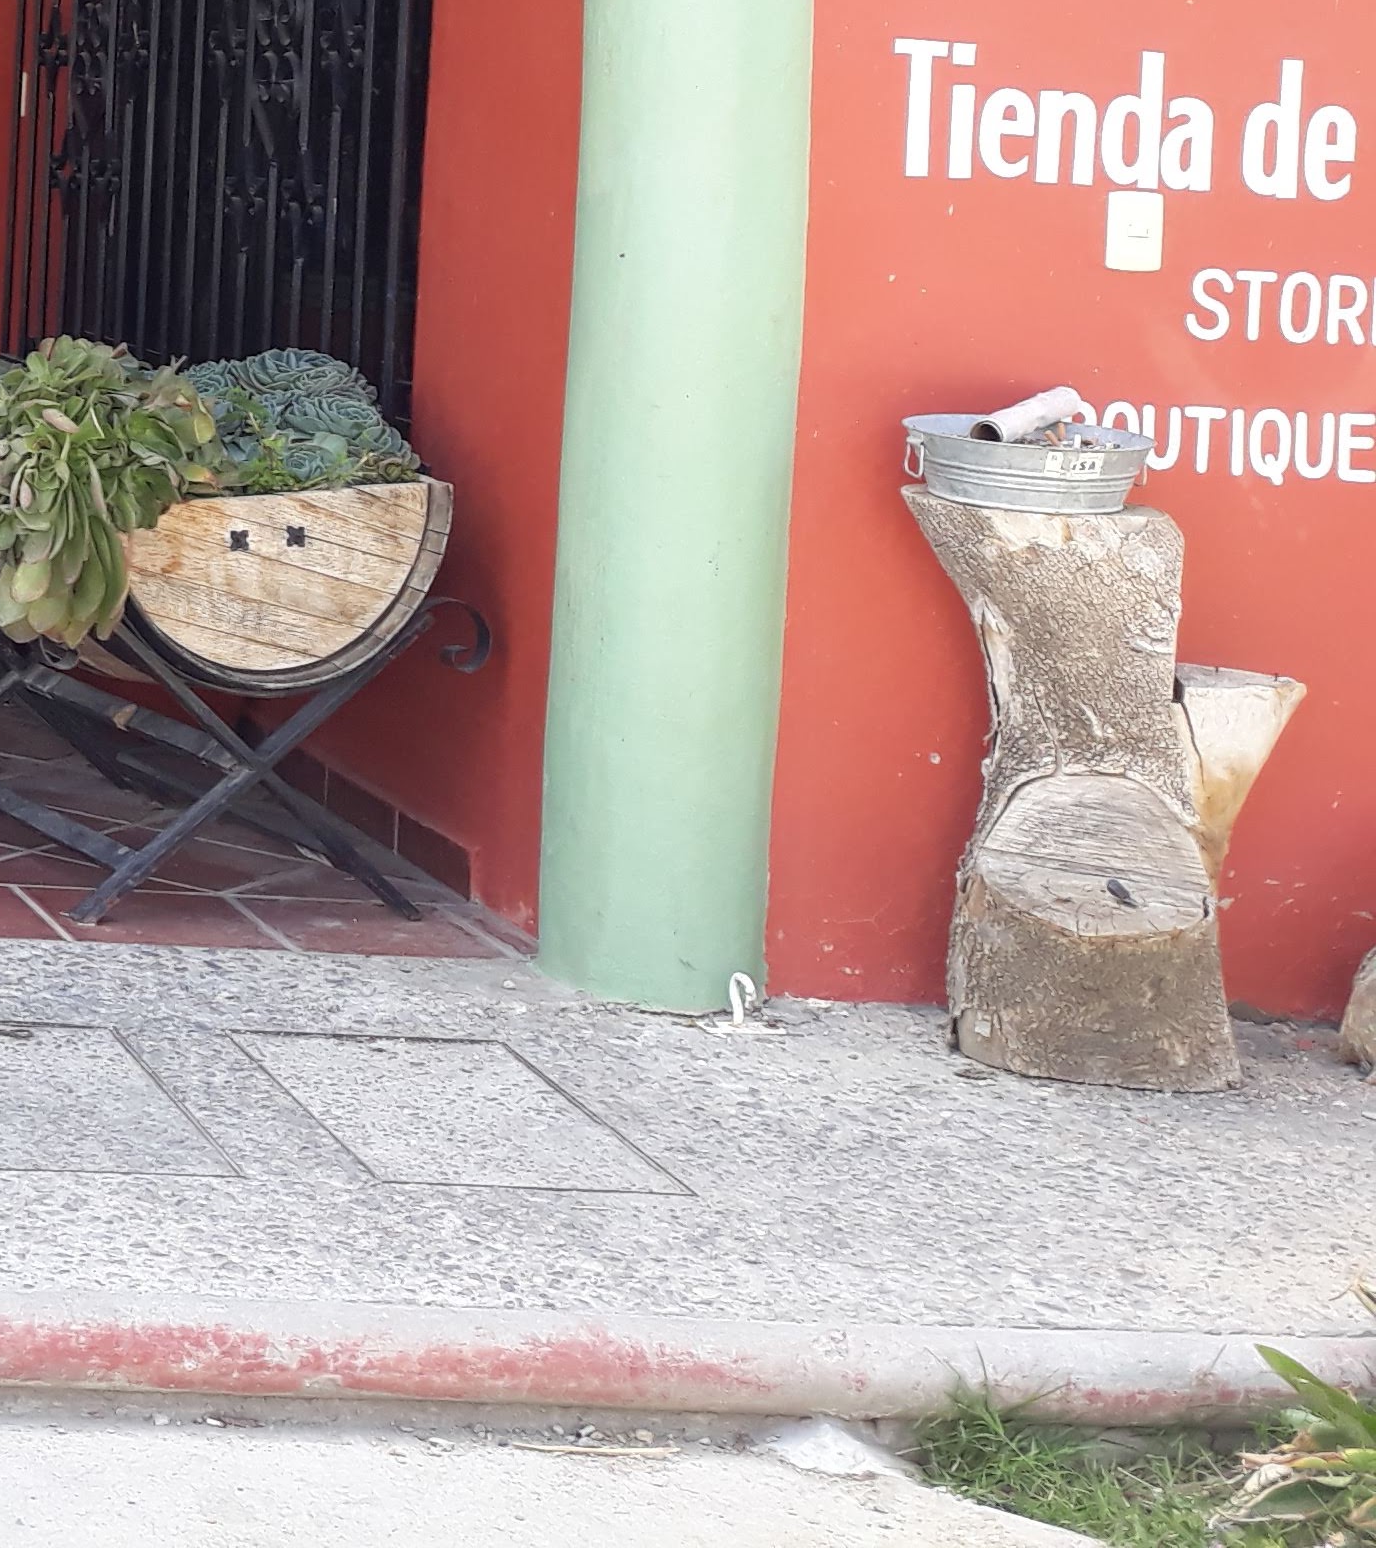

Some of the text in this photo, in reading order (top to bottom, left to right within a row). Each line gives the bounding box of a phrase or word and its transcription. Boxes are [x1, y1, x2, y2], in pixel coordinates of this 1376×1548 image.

[893, 37, 1357, 201] Tienda de
[1185, 268, 1376, 346] STOR
